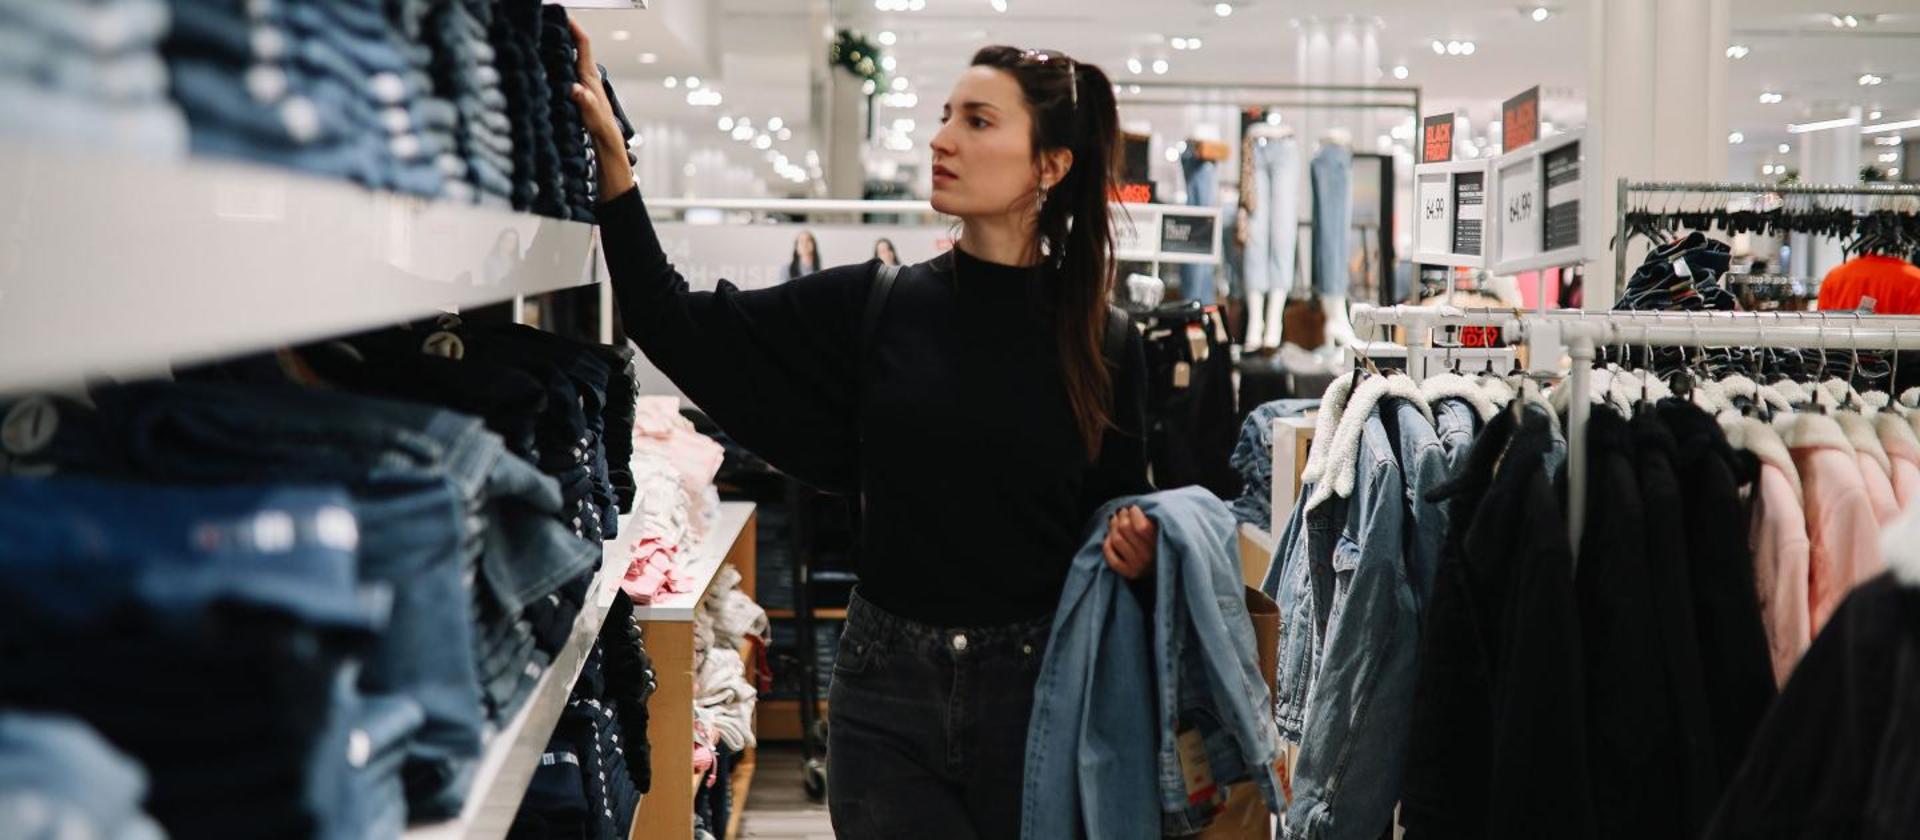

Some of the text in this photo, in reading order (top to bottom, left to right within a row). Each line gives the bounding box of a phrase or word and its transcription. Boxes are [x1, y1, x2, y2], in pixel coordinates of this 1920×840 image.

[1426, 123, 1451, 143] BLACK
[1426, 142, 1450, 161] FRIDAY
[1426, 198, 1444, 220] 64.99
[1509, 192, 1532, 222] 64.99
